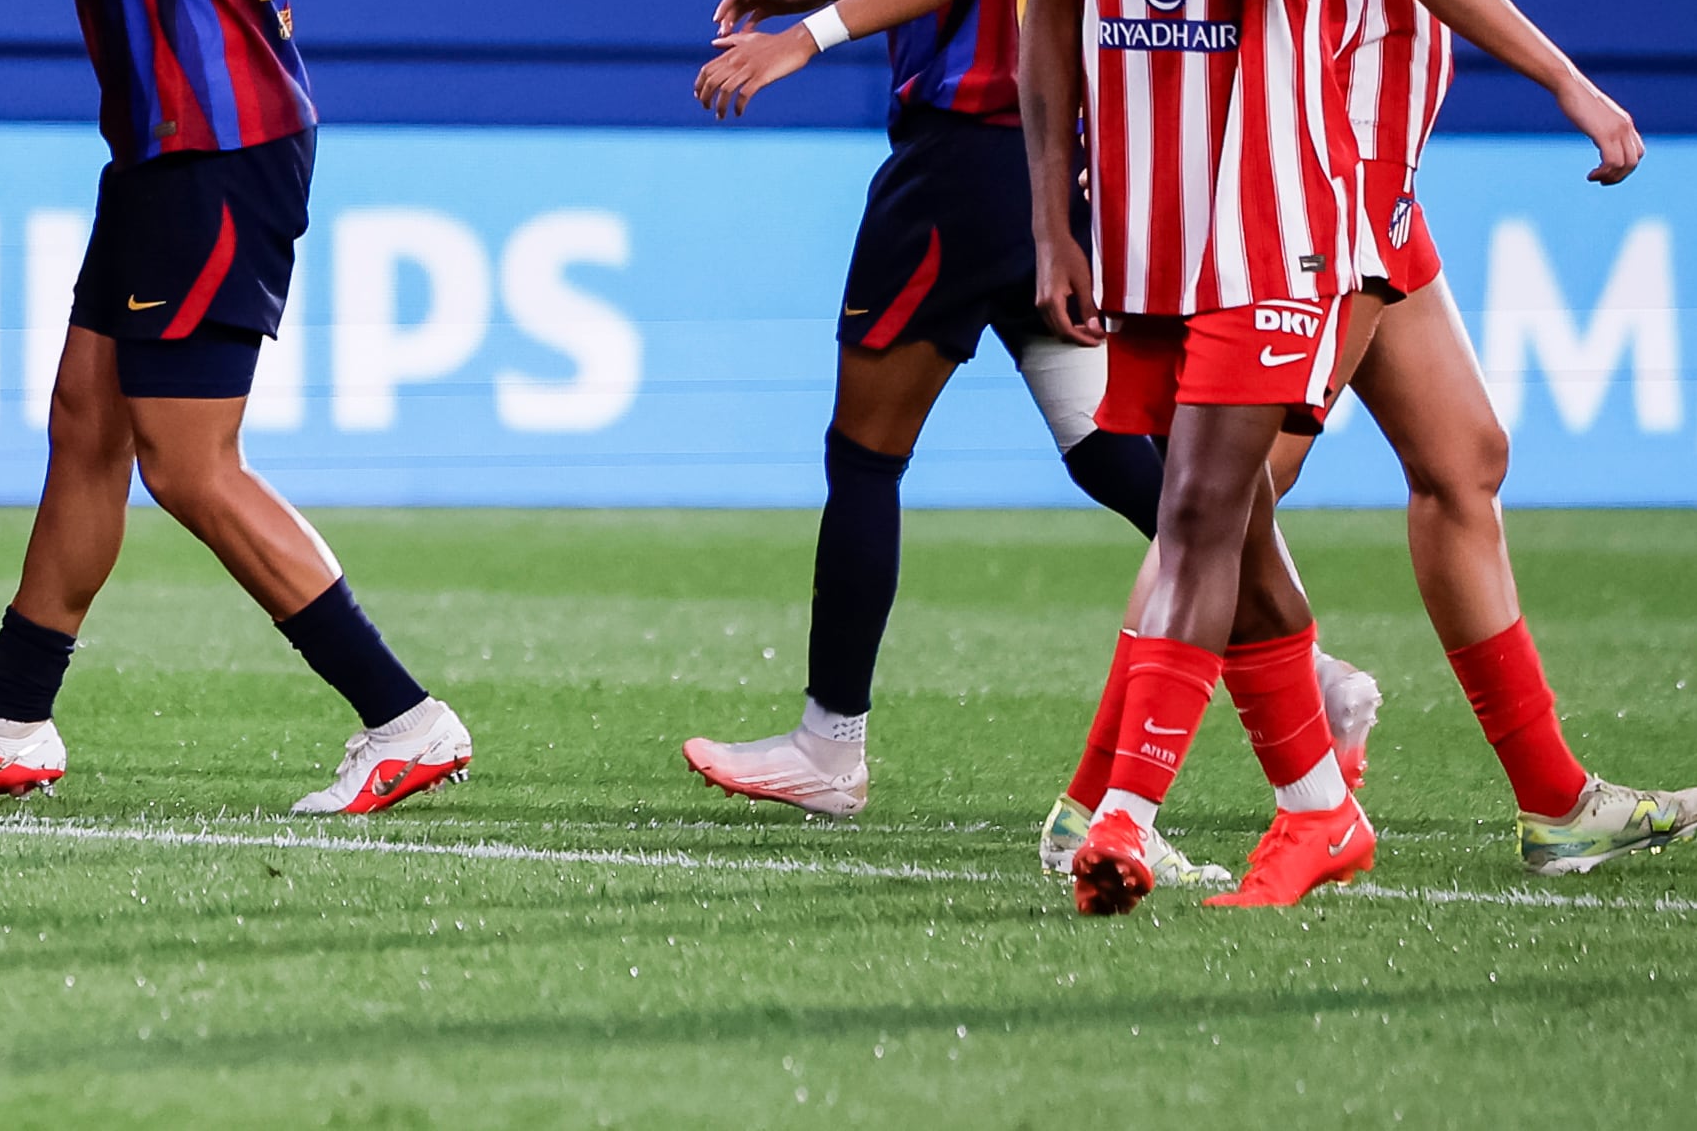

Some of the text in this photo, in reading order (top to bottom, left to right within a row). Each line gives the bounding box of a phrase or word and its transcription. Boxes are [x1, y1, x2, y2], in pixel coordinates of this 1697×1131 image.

[1099, 21, 1237, 49] RIYADH AIR
[1255, 309, 1319, 338] DKV
